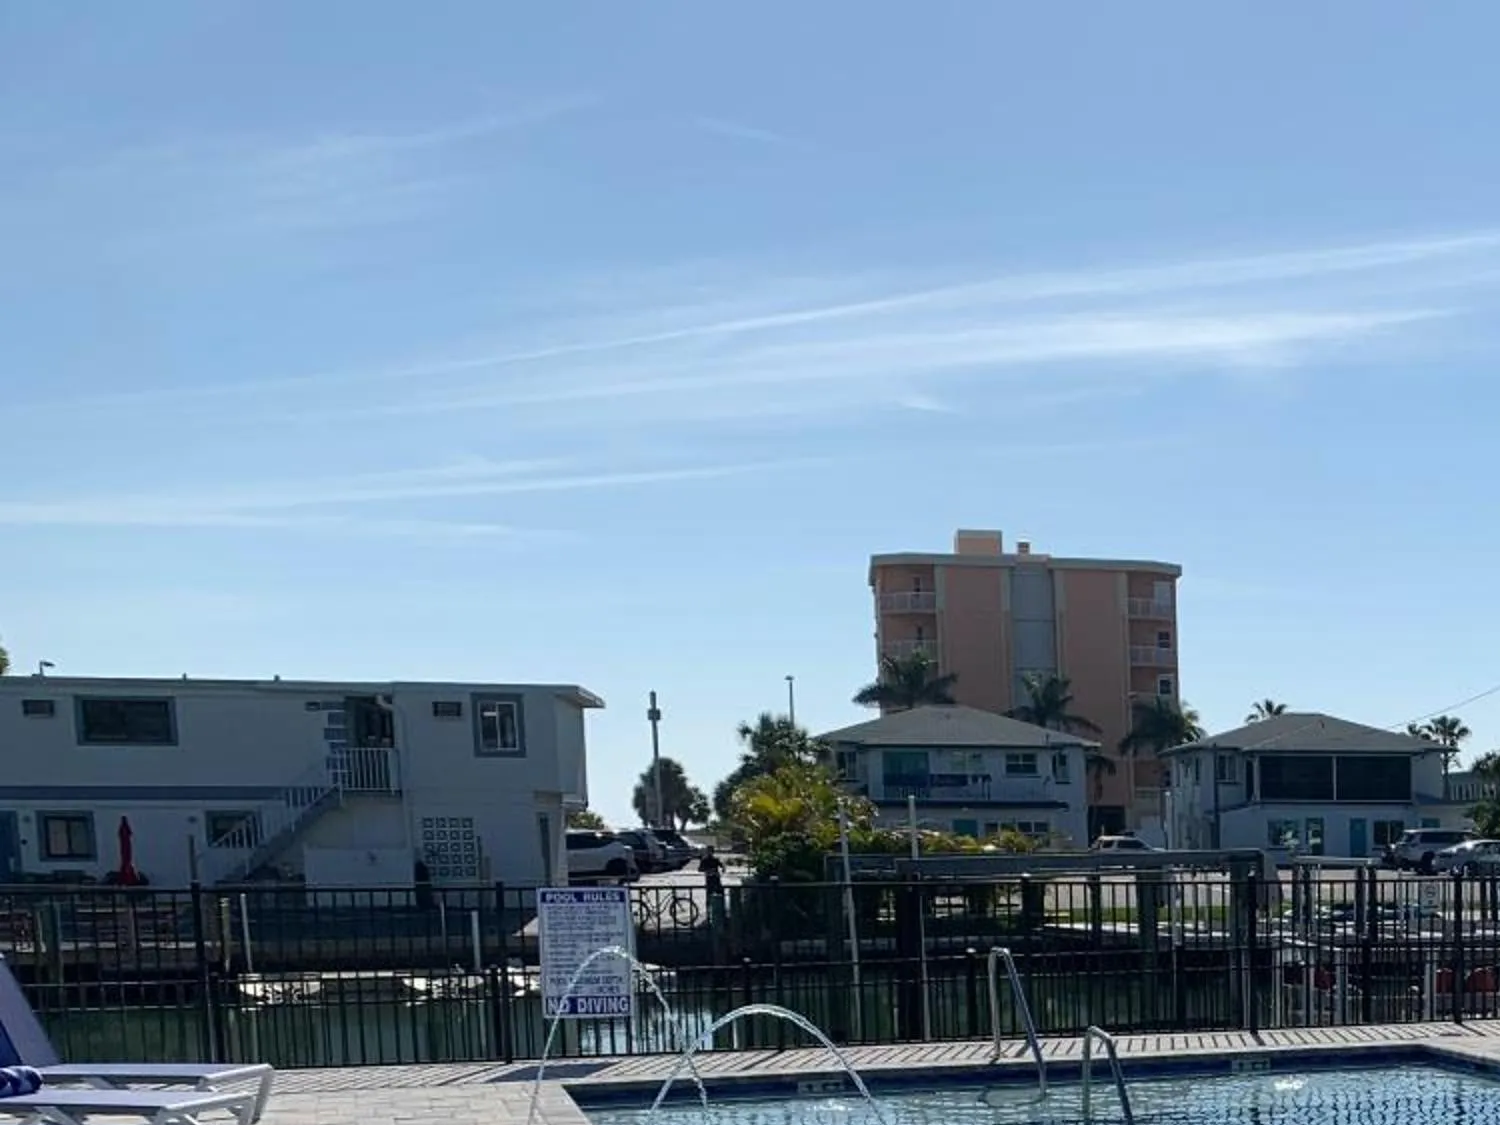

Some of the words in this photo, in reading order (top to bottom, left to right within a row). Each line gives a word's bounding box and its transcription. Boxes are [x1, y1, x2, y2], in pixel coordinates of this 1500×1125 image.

[546, 892, 576, 902] POOL
[584, 892, 620, 902] RULES
[547, 997, 570, 1013] NO
[577, 996, 629, 1012] DIVING
